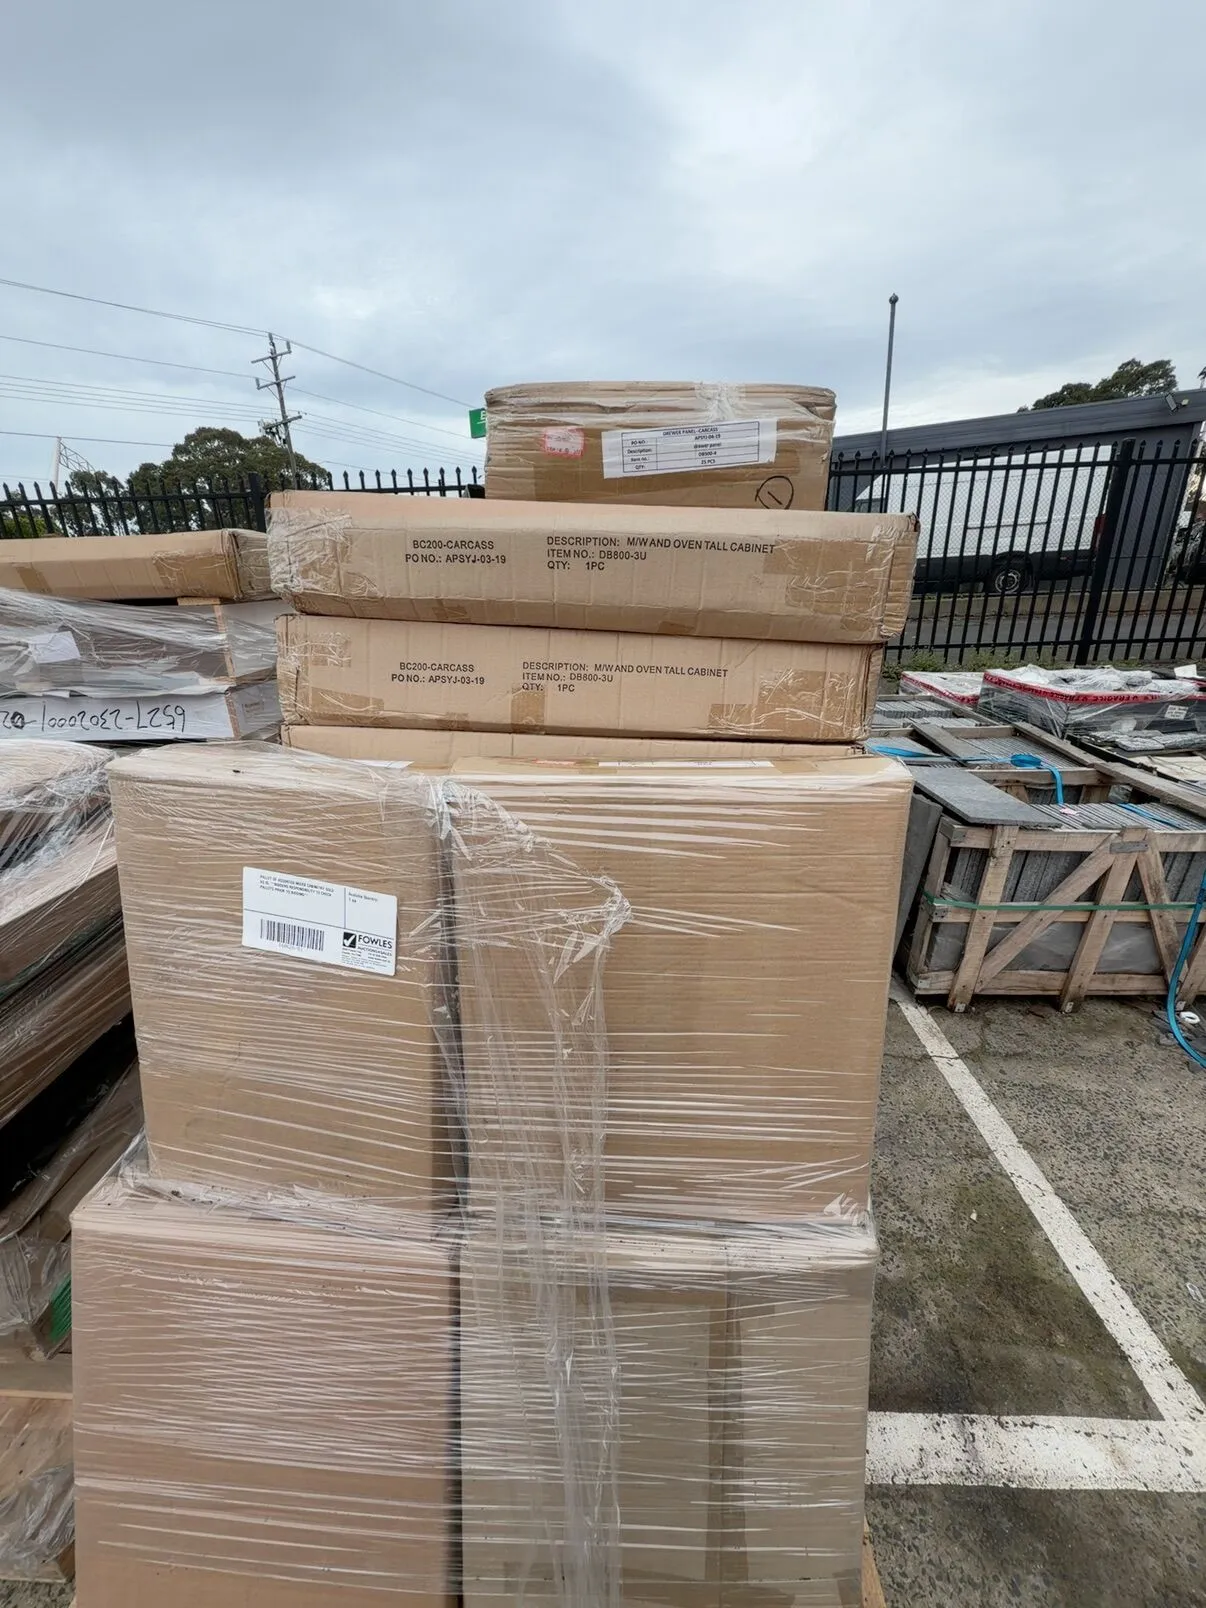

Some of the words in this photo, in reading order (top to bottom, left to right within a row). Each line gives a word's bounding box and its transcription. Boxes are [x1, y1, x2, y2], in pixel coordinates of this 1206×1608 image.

[412, 539, 495, 550] BC200-CARCASS
[546, 536, 620, 547] DESCRIPTION:
[649, 538, 672, 549] AND
[673, 539, 703, 550] OVEN
[704, 540, 729, 551] TALL
[729, 542, 776, 554] CABINET
[405, 553, 420, 563] PO
[445, 554, 507, 565] APSYJ-03-19
[546, 549, 571, 558] ITEM
[599, 550, 647, 560] DB800-3U
[546, 560, 570, 570] QTY:
[585, 561, 605, 571] 1PC
[399, 661, 475, 672] BC200-CARCASS
[522, 661, 589, 672] DESCRIPTION:
[614, 664, 635, 673] AND
[635, 665, 662, 674] OVEN
[664, 666, 686, 675] TALL
[687, 667, 729, 678] CABINET
[391, 673, 405, 682] PO
[428, 675, 485, 685] APSYJ-03-19
[522, 672, 545, 681] ITEM
[569, 672, 614, 683] DB800-3U
[522, 682, 544, 692] QTY:
[558, 684, 575, 693] 1PC
[358, 934, 393, 949] FOWLES
